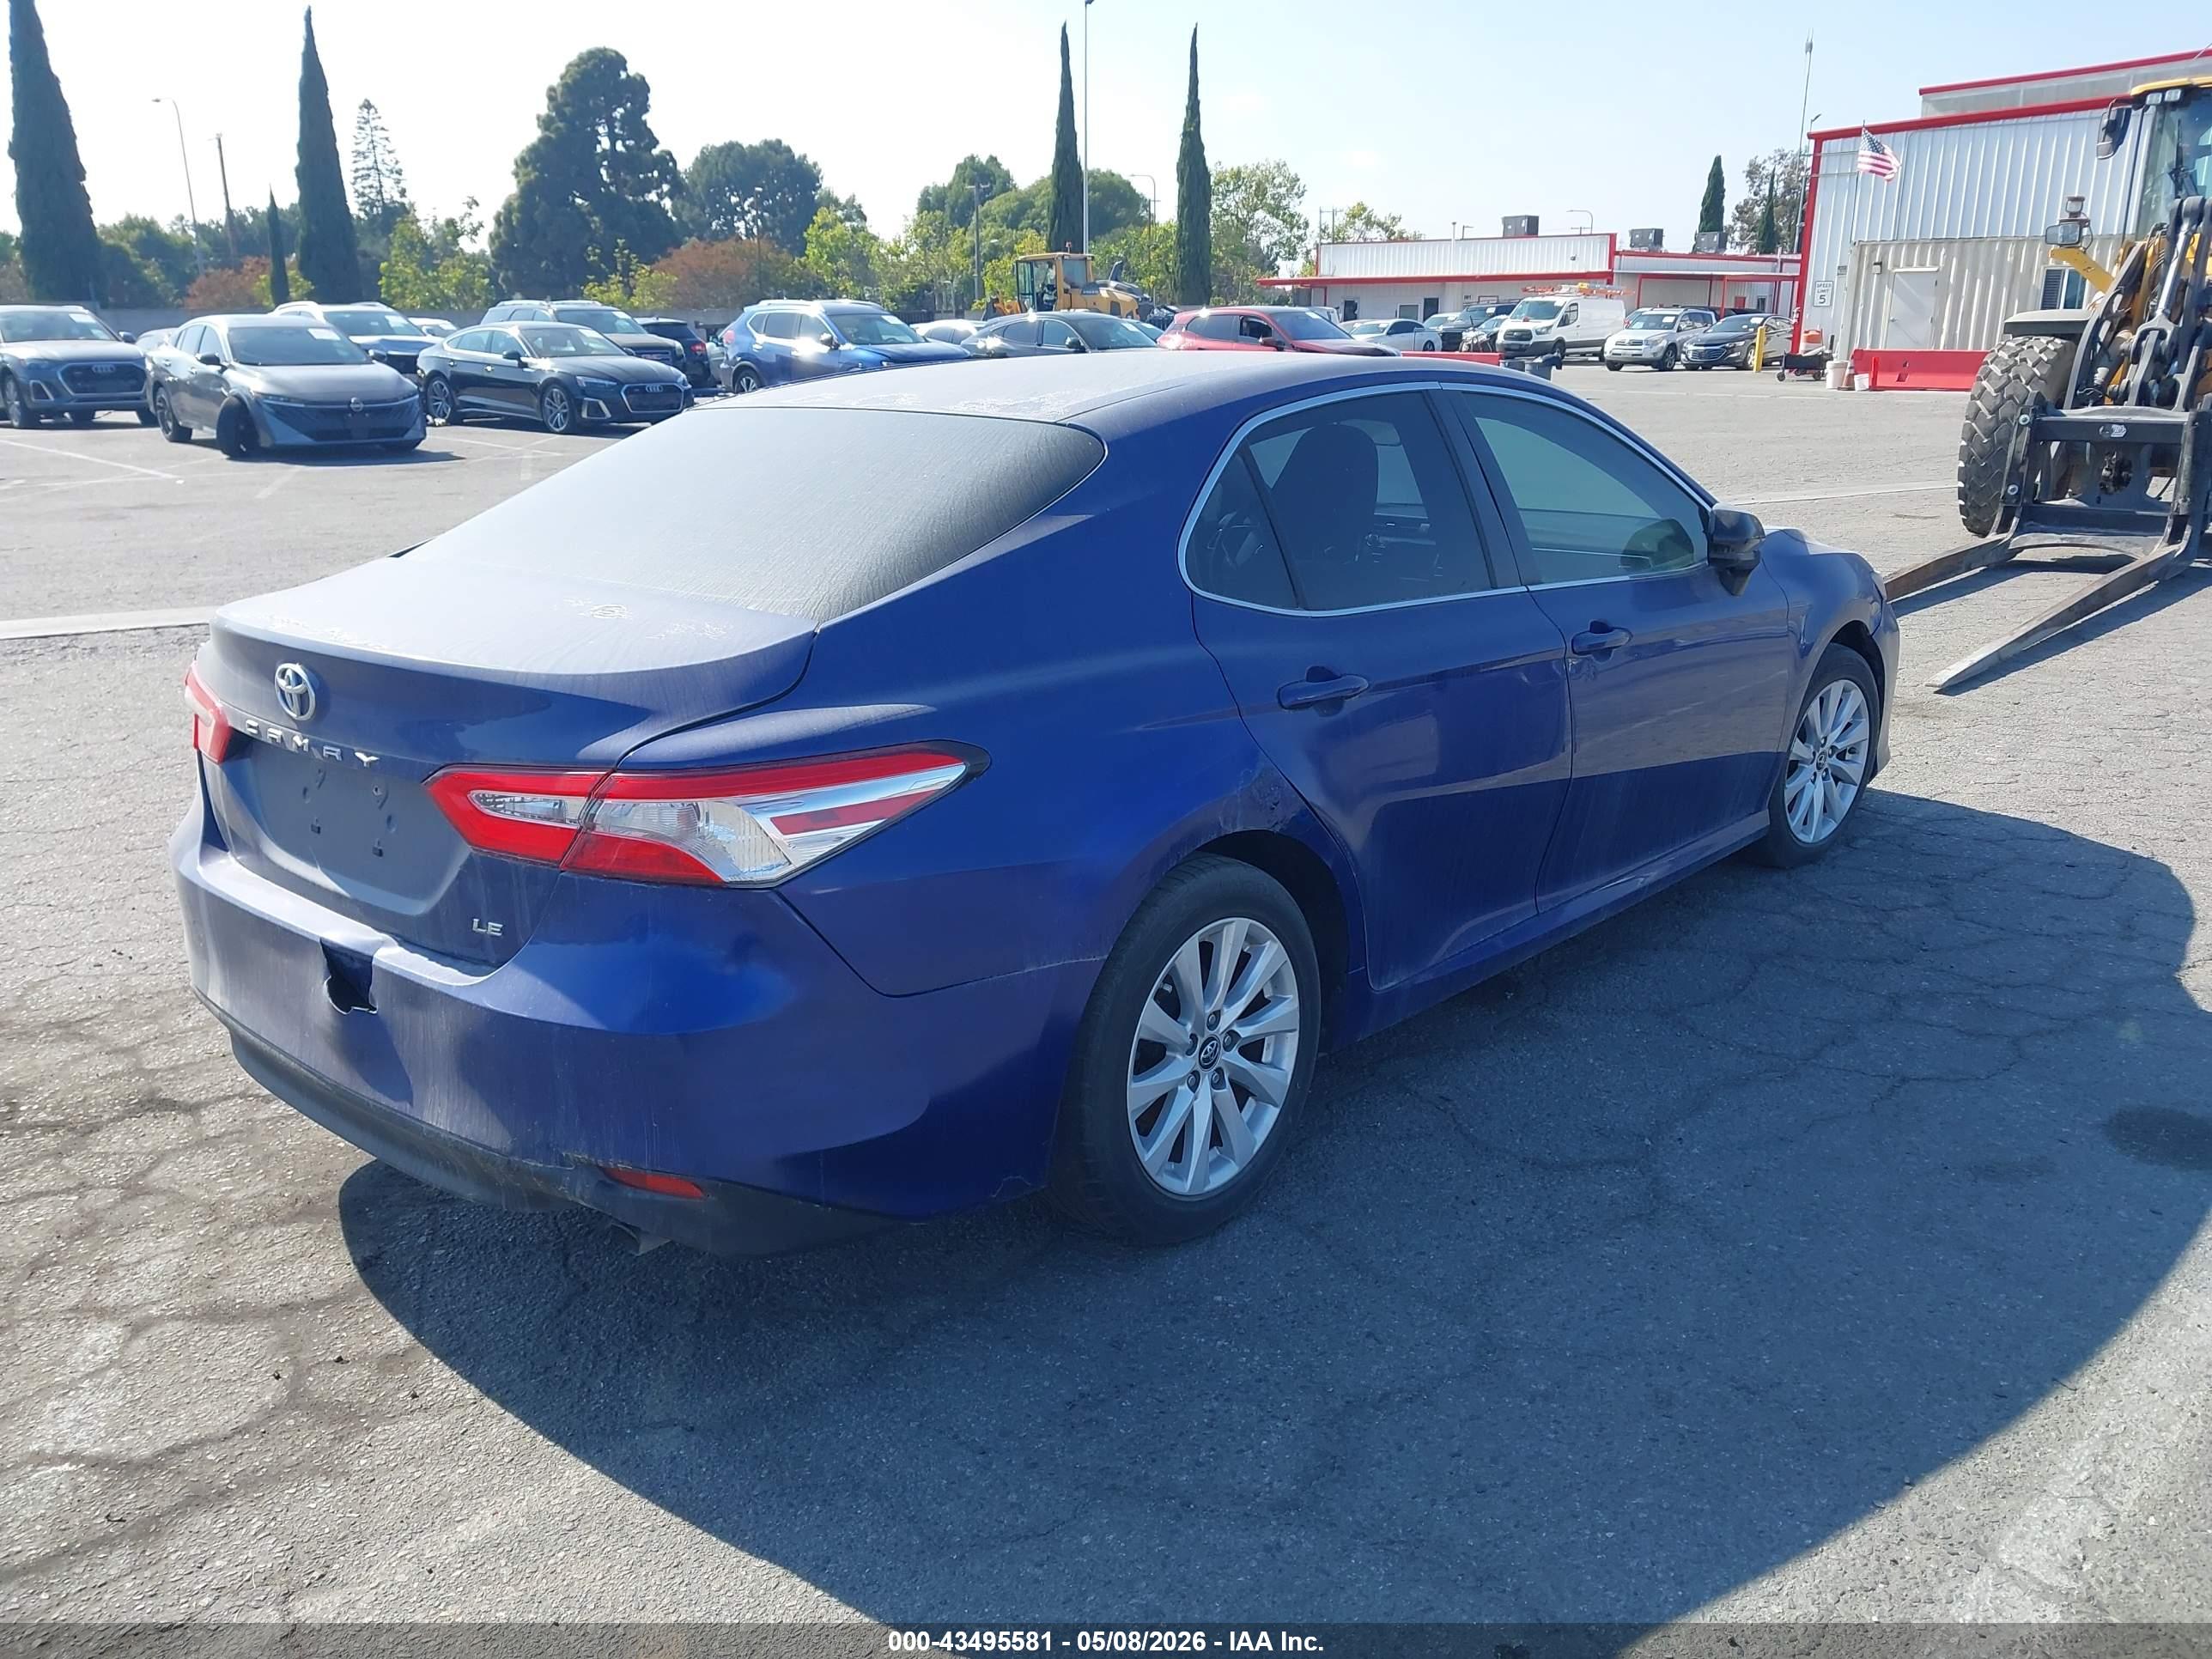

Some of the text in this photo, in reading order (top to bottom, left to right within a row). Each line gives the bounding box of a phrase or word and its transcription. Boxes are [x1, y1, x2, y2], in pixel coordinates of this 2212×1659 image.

[1819, 295, 1826, 304] 5
[245, 720, 380, 768] CAMRY
[472, 918, 503, 936] LE
